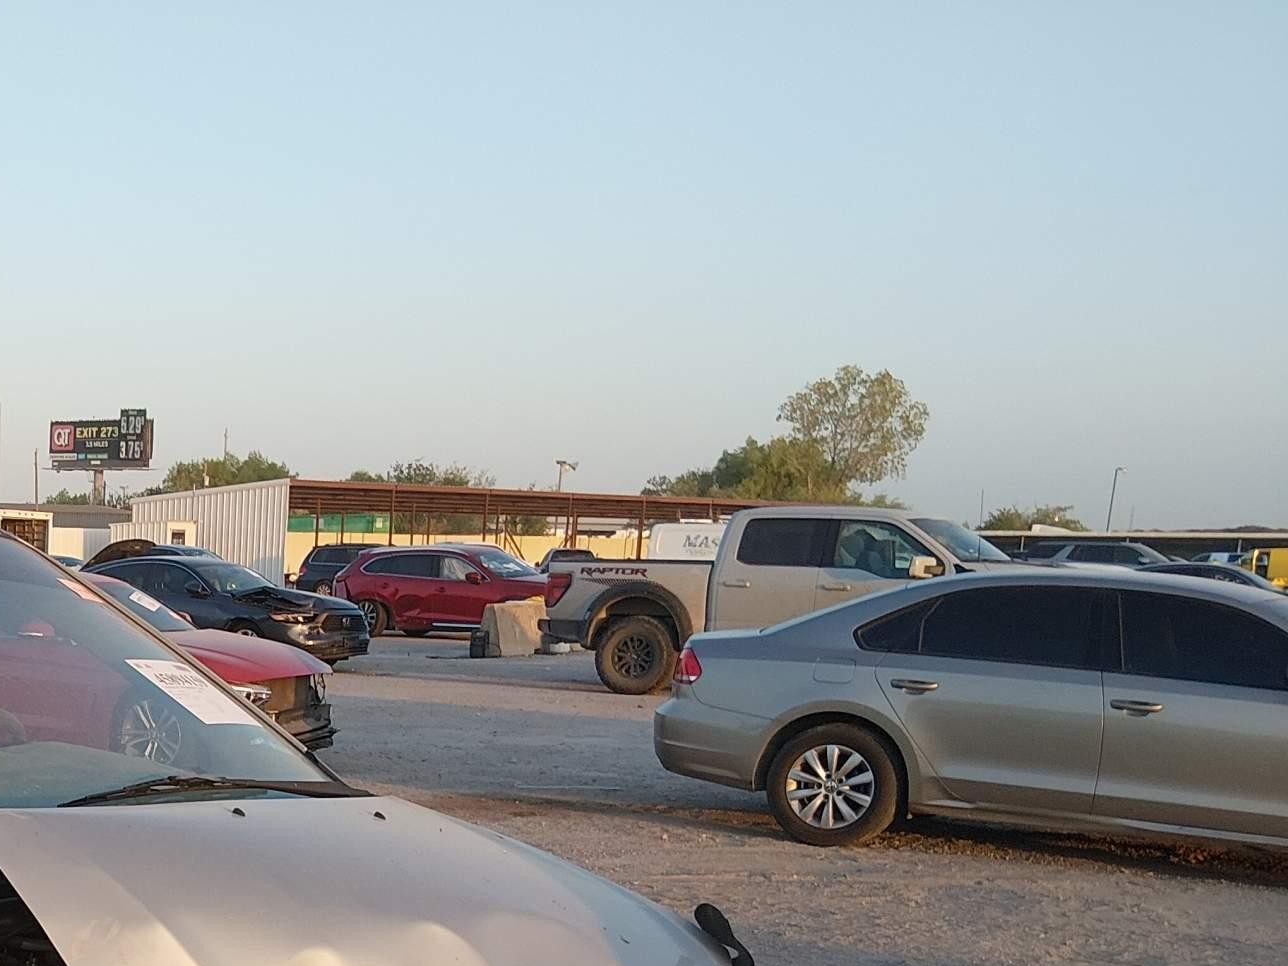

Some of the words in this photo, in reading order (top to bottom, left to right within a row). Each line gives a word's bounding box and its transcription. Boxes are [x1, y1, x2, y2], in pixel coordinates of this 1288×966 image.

[54, 428, 71, 448] QT
[75, 427, 98, 438] EXIT
[100, 426, 119, 438] 273
[580, 567, 648, 578] RAPTOR
